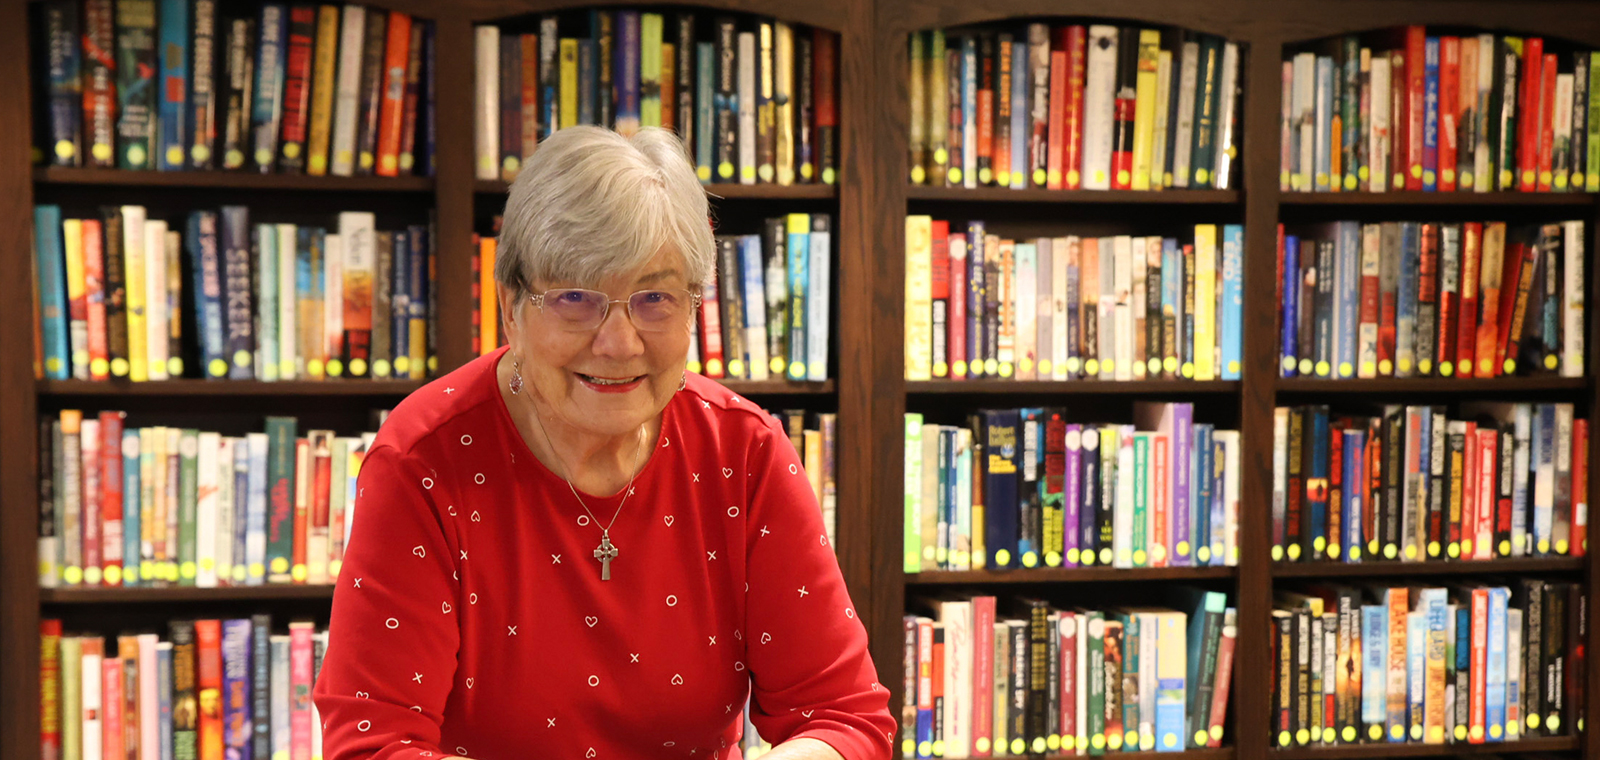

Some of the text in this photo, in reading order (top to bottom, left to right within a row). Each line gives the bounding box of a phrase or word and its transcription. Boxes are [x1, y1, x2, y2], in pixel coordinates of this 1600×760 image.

[1000, 42, 1013, 117] DEAN KOONTZ
[1222, 241, 1235, 281] END
[226, 249, 250, 340] SEEKER
[1164, 319, 1175, 357] LEWIS
[1178, 418, 1187, 487] DEBBIE MACOMBER
[920, 625, 933, 663] ARSENIC
[1339, 596, 1352, 655] PATTERSON
[1350, 609, 1361, 639] JAMES
[1369, 611, 1382, 637] JUDGE
[1429, 599, 1446, 661] LIFEGUARD
[1014, 633, 1025, 709] LIBRARIAN SPY
[1369, 649, 1382, 668] JURY
[1390, 638, 1405, 672] HOUSE
